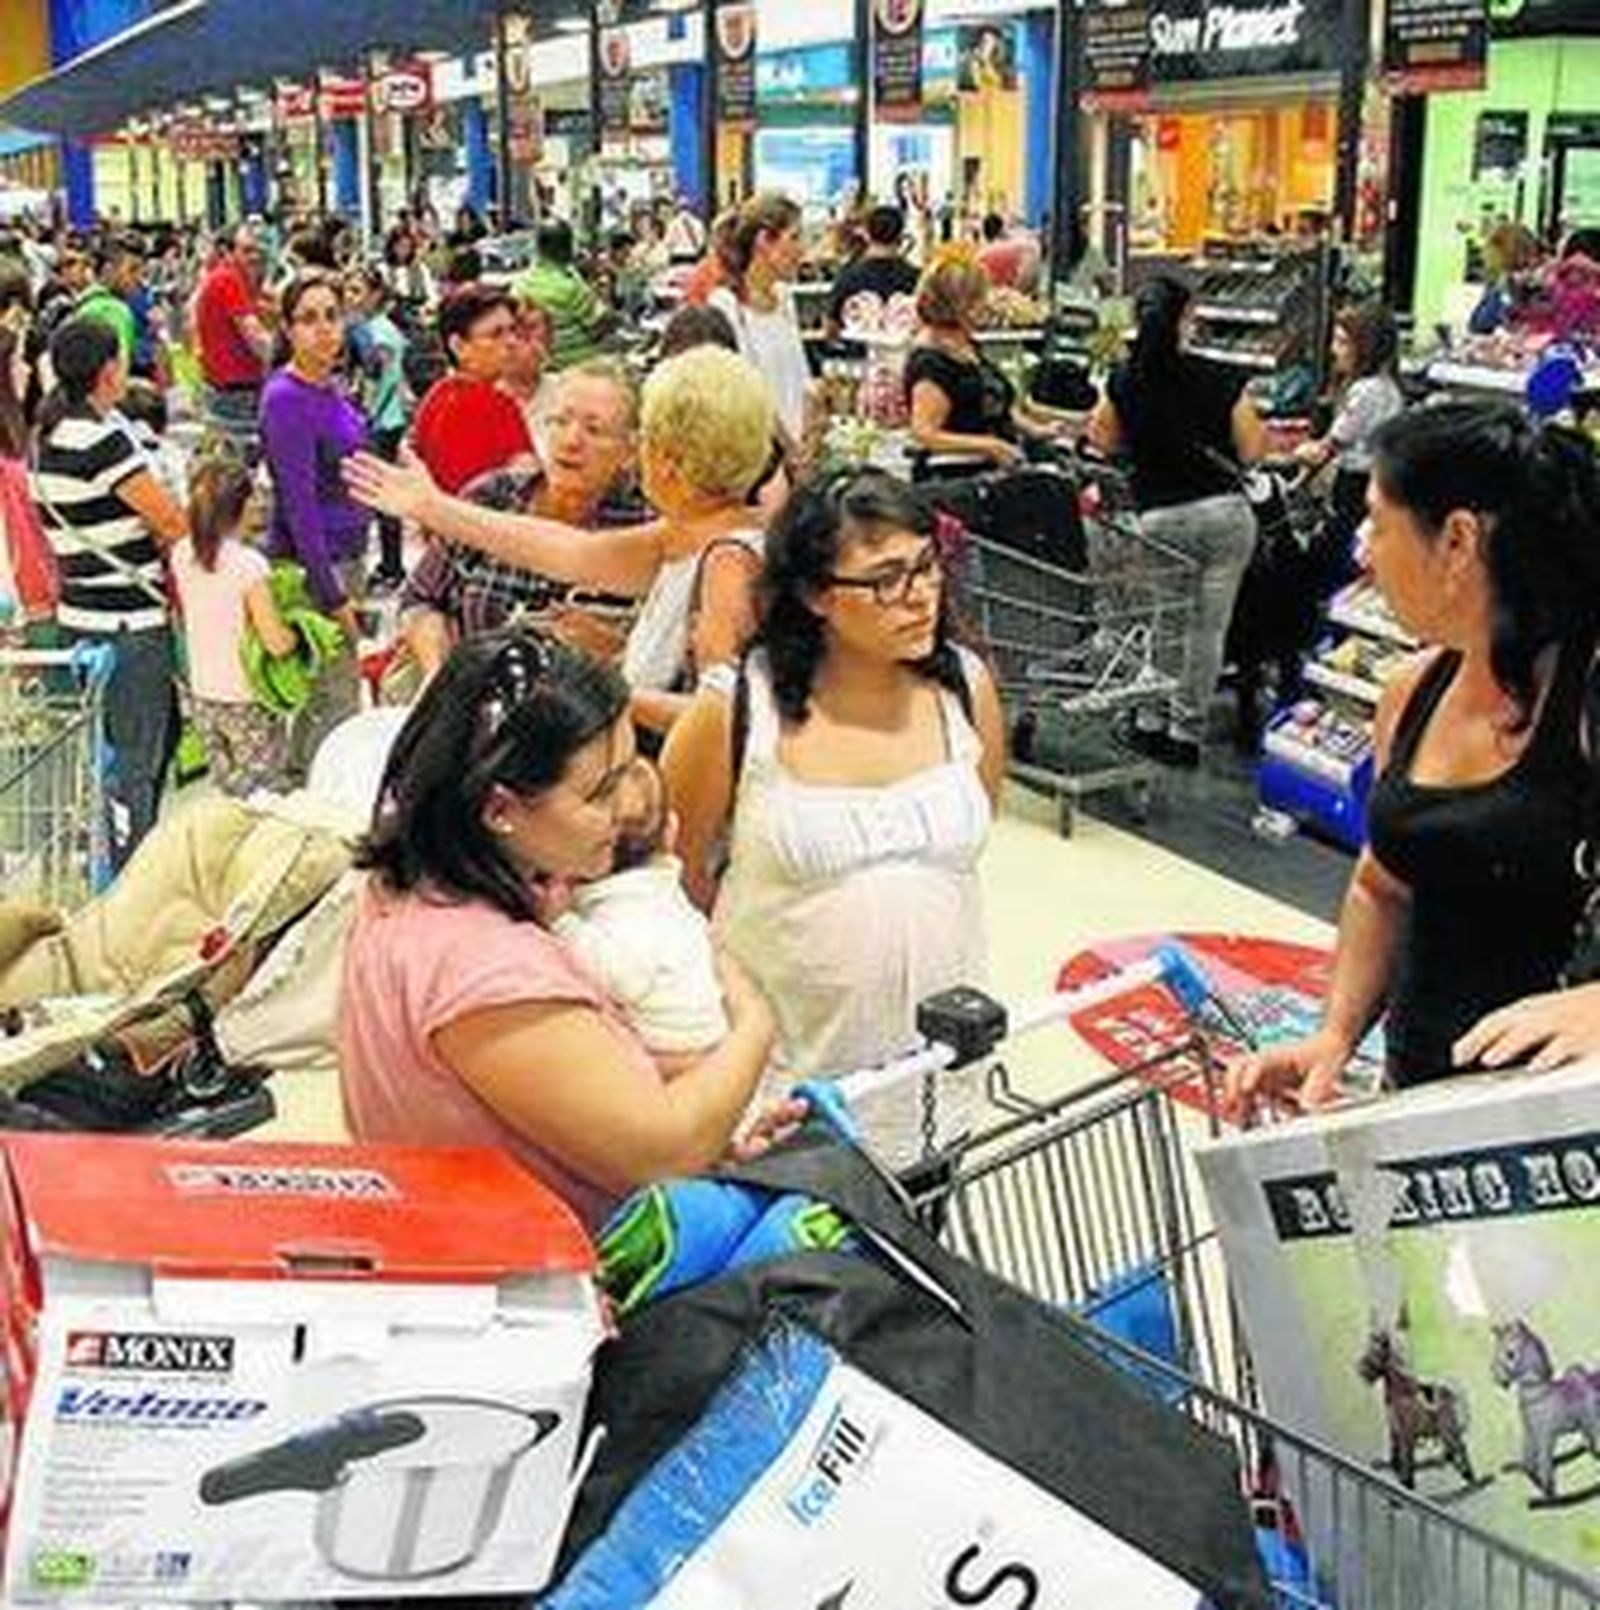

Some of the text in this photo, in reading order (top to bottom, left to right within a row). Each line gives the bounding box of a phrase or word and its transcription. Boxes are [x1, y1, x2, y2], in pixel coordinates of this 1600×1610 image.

[1151, 13, 1200, 56] Sun
[1201, 0, 1304, 52] Planet
[1522, 1147, 1600, 1205] HO
[105, 1336, 228, 1370] MONIX
[57, 1386, 269, 1420] Veloce
